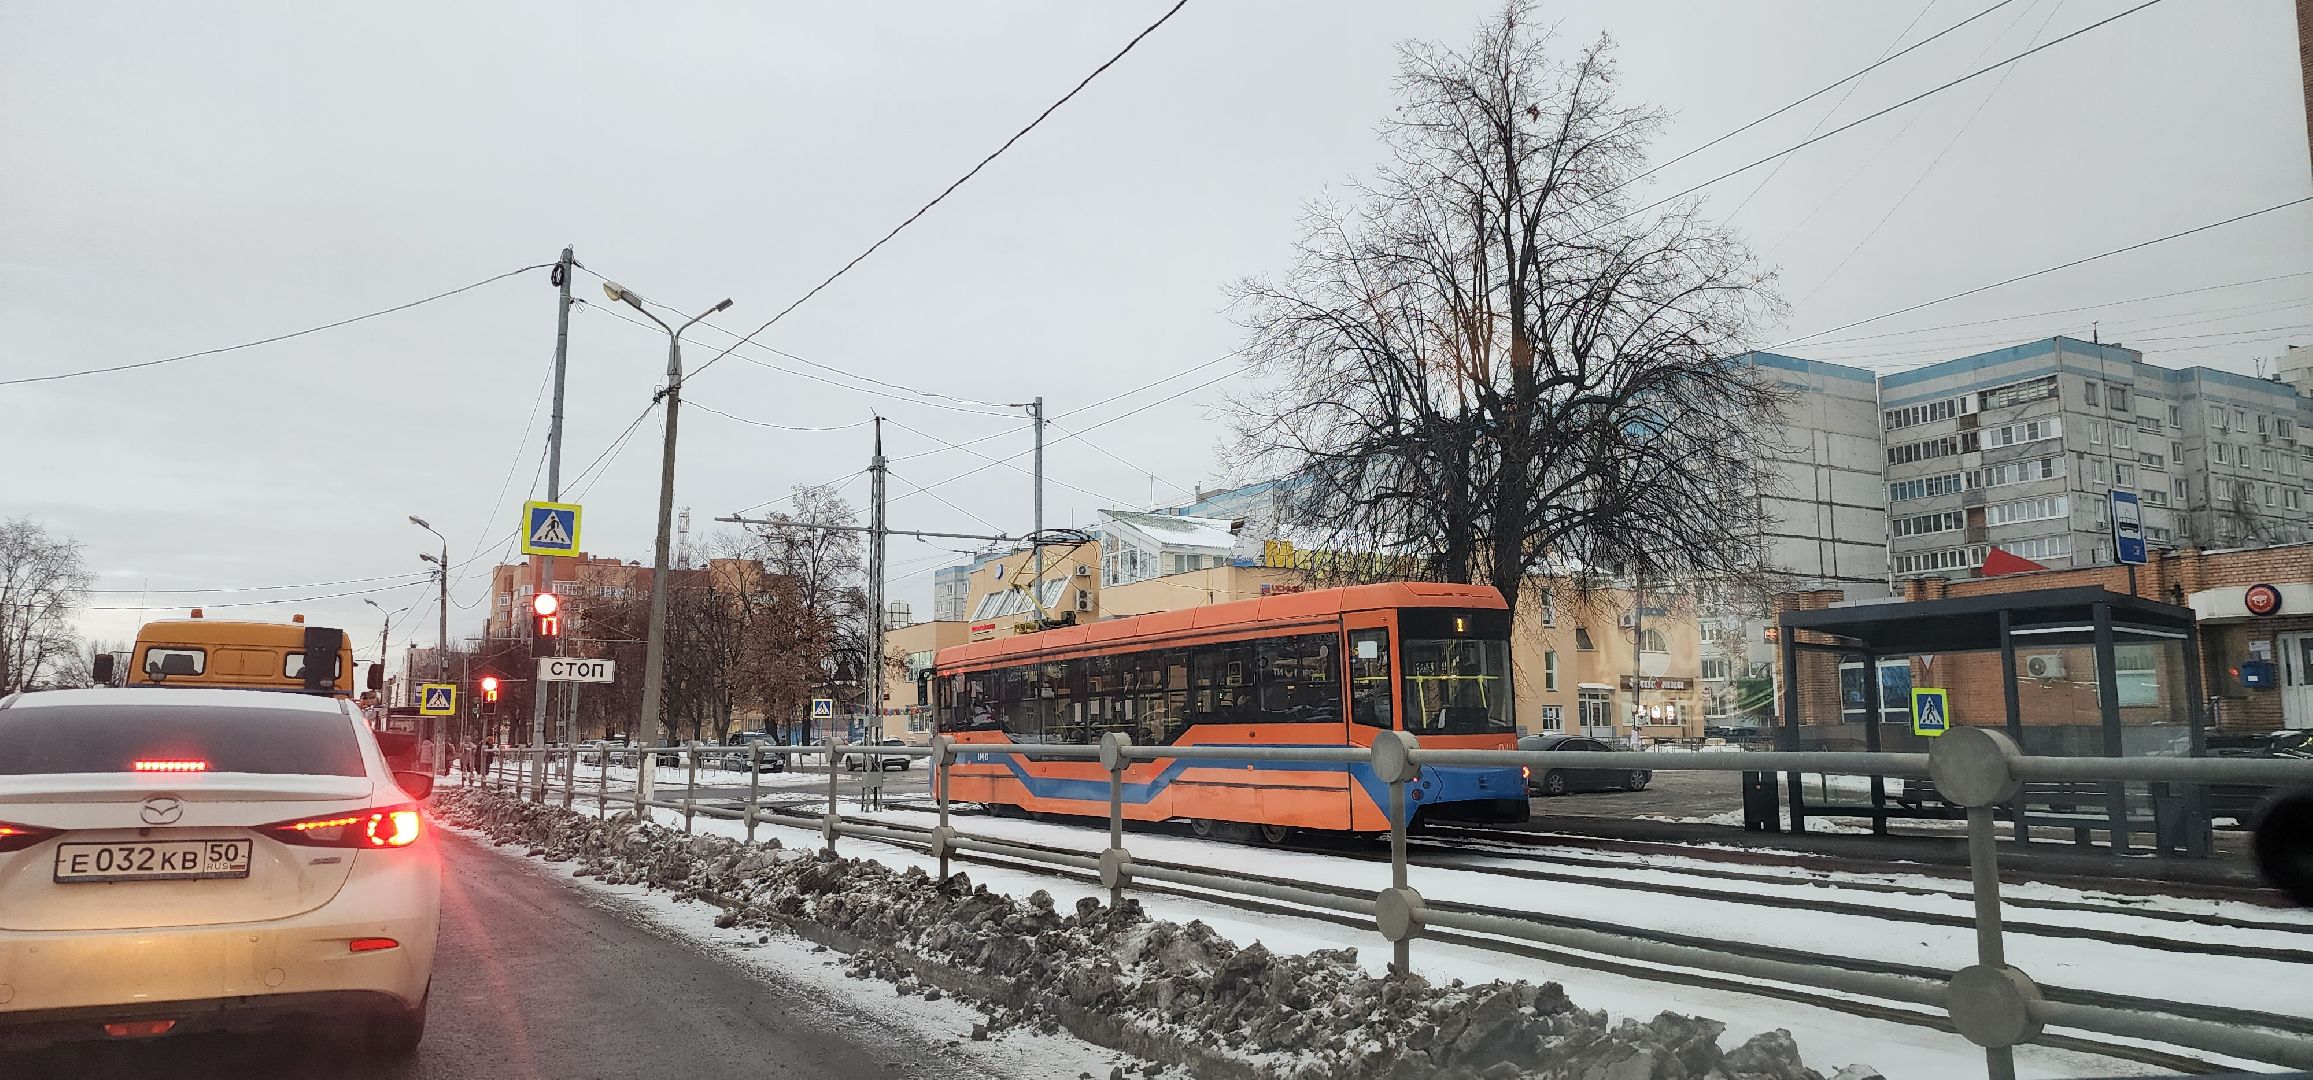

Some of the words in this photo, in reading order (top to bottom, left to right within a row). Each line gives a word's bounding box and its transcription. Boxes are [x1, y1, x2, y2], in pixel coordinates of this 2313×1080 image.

[1456, 618, 1463, 631] 1
[551, 662, 603, 677] СТОП
[208, 843, 240, 862] 50
[206, 862, 230, 871] RUS
